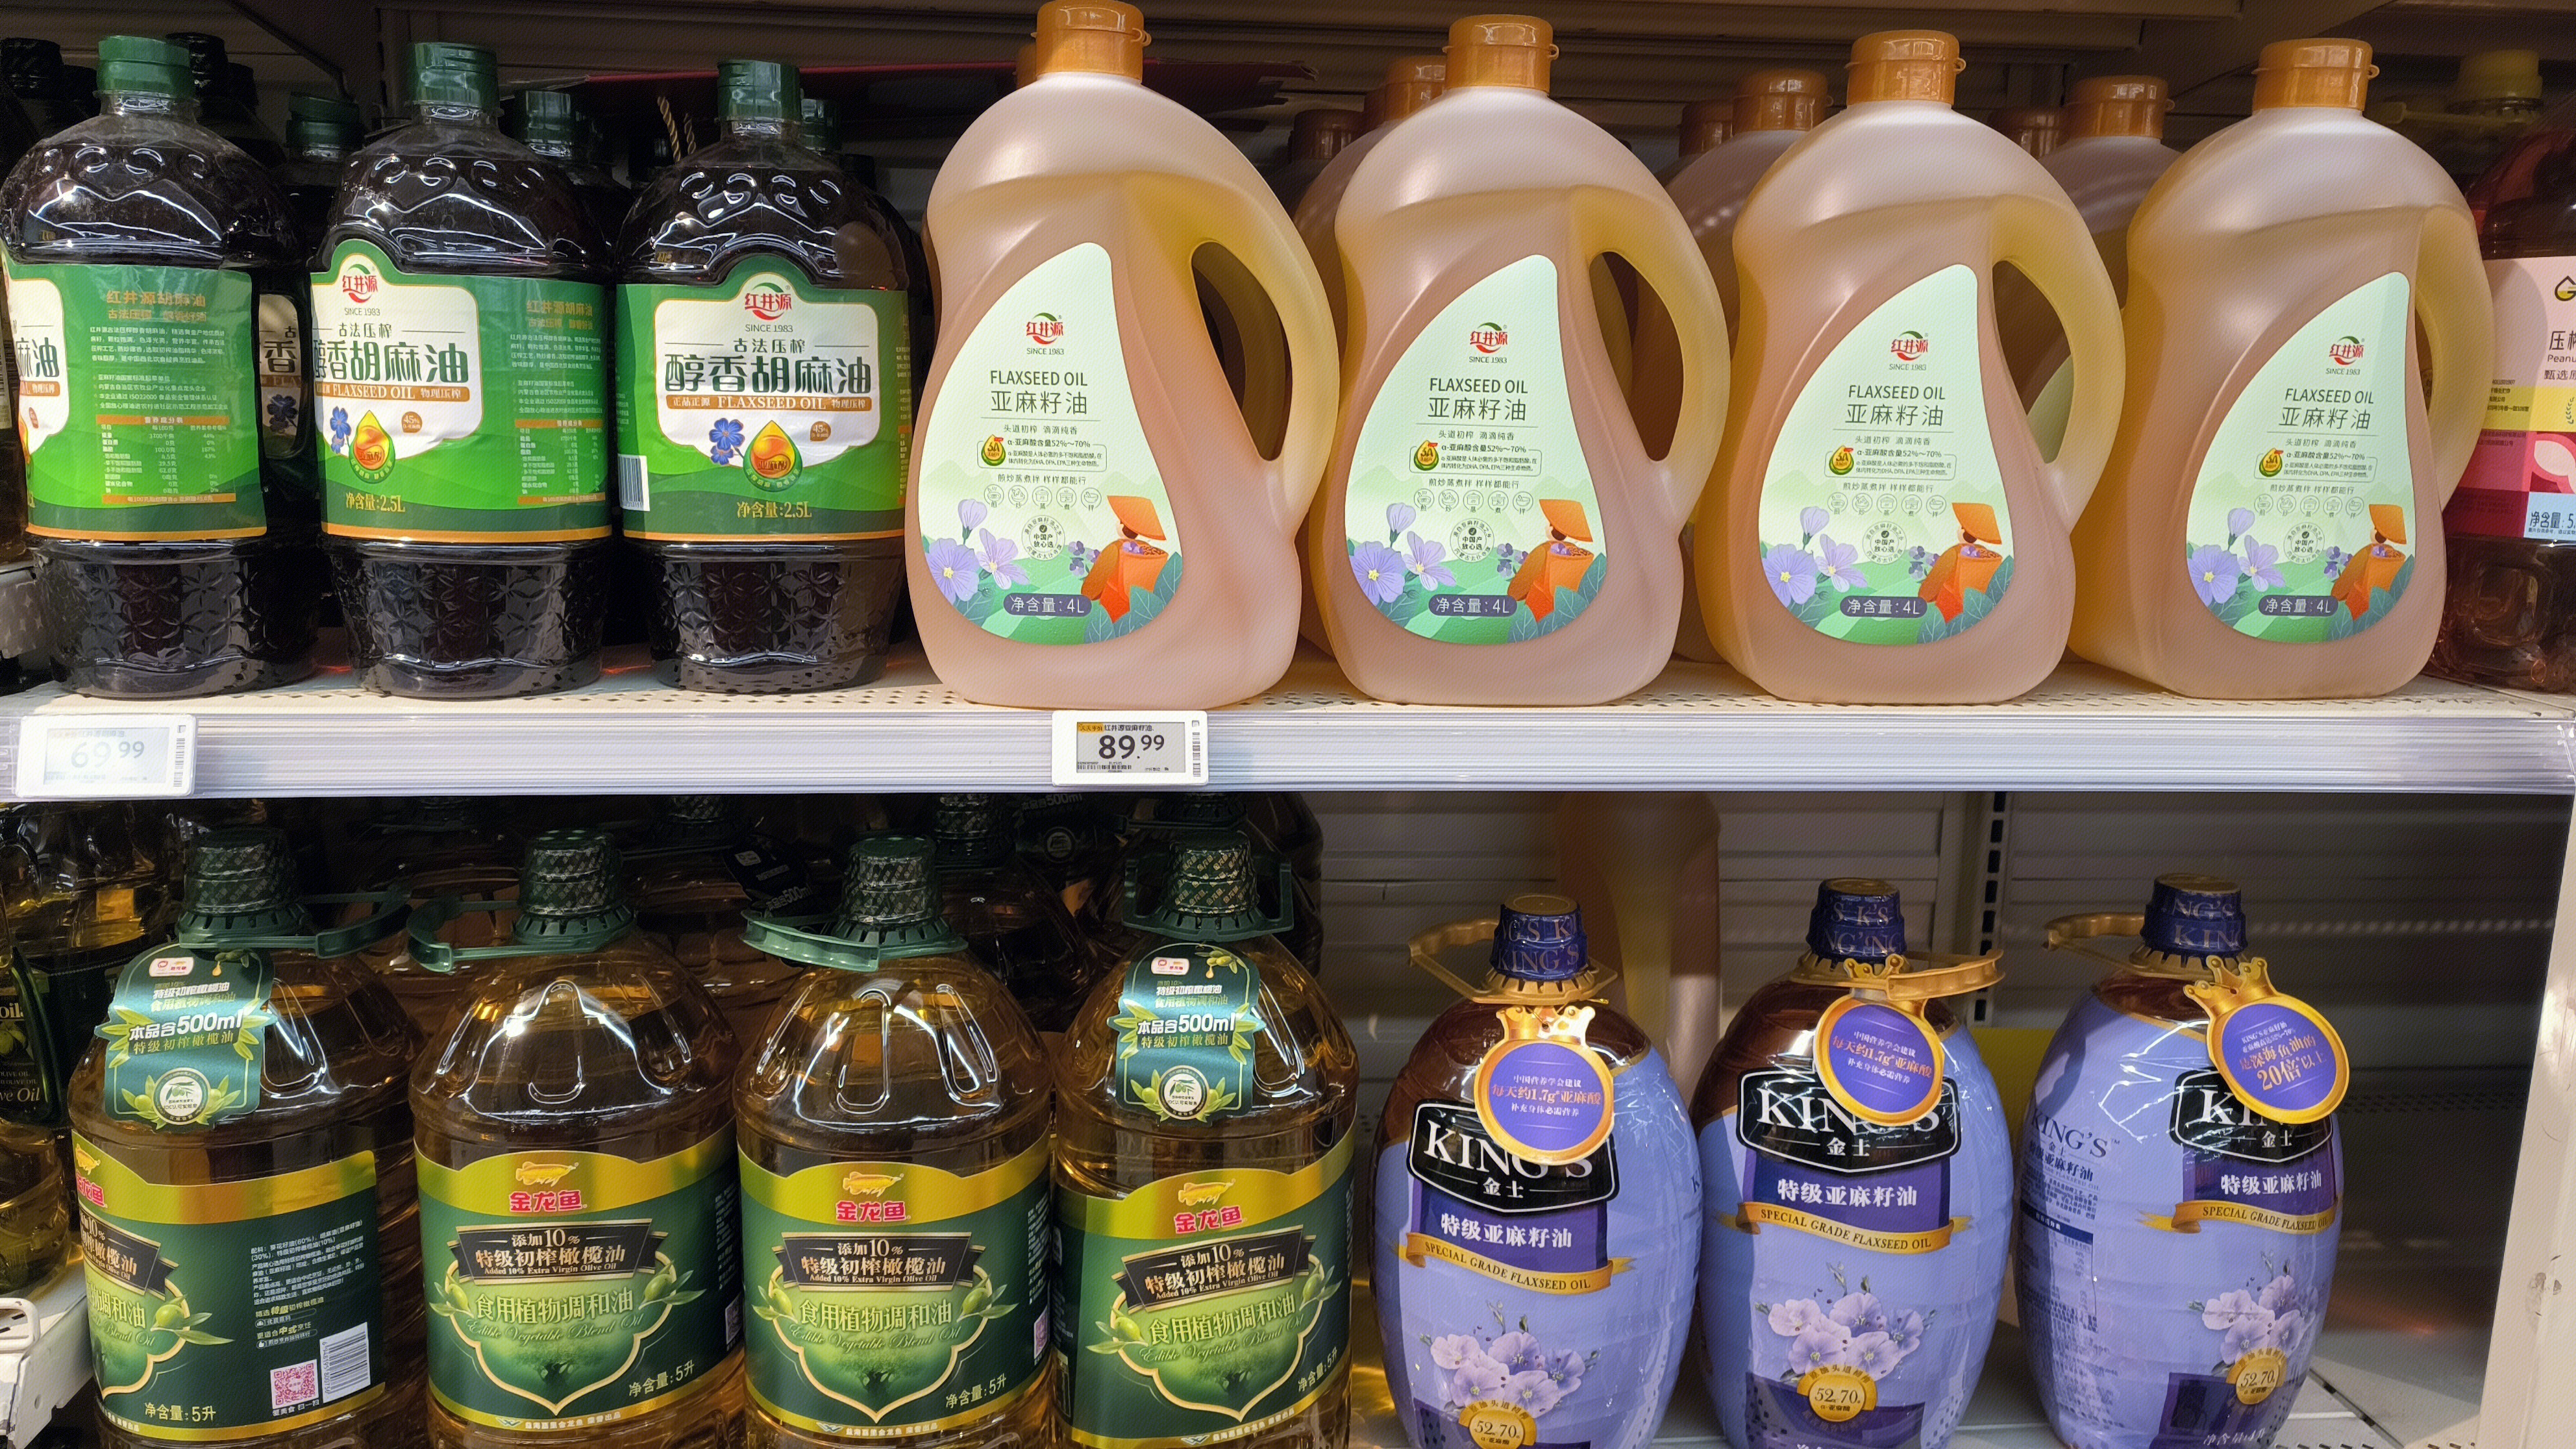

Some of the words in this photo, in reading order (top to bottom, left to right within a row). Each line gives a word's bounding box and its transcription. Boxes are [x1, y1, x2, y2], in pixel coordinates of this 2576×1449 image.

[342, 275, 378, 293] 红井源
[107, 291, 205, 307] 红井源胡麻油
[745, 293, 792, 312] 红井源
[344, 307, 362, 316] SINCE
[364, 308, 380, 316] 1983
[338, 322, 391, 339] 古法压榨
[745, 323, 771, 332] SINCE
[1026, 321, 1063, 337] 红井源
[1470, 331, 1508, 345] 红井源
[733, 338, 806, 353] 古法压榨
[1891, 339, 1928, 354] 红井源
[2329, 344, 2364, 358] 红井源
[665, 354, 871, 394] 醇香胡麻油
[991, 371, 1059, 386] FLAXSEED
[1065, 372, 1087, 386] OIL
[333, 384, 387, 398] FLAXSEED
[390, 386, 415, 399] OIL
[1430, 378, 1500, 393] FLAXSEED
[1505, 380, 1528, 393] OIL
[1849, 385, 1919, 399] FLAXSEED
[1923, 386, 1946, 400] OIL
[2285, 388, 2351, 403] FLAXSEED
[2355, 390, 2373, 404] OIL
[717, 397, 796, 408] FLAXSEED
[800, 398, 826, 409] OIL
[991, 391, 1087, 414] 亚麻籽油
[1428, 397, 1526, 421] 亚麻籽油
[1845, 404, 1944, 427] 亚麻籽油
[2279, 407, 2371, 430] 亚麻籽油
[1098, 735, 1164, 759] 89.99
[129, 1009, 243, 1040] 本品含500ml
[1137, 1013, 1236, 1034] 本品含500ml
[133, 1031, 234, 1055] 特级初榨橄榄油
[1141, 1034, 1228, 1048] 特级初榨橄榄油
[18, 1087, 40, 1102] Oil
[1827, 1137, 1871, 1156] 金士
[2262, 1130, 2292, 1148] 金士
[1483, 1177, 1524, 1198] 金士
[1777, 1179, 1917, 1208] 特级亚麻籽油
[2221, 1170, 2322, 1195] 特级亚麻籽油
[510, 1190, 582, 1213] 金龙鱼
[836, 1200, 907, 1222] 金龙鱼
[1174, 1205, 1243, 1233] 金龙鱼
[1761, 1208, 1807, 1227] SPECIAL
[1811, 1220, 1850, 1239] GRADE
[1853, 1233, 1908, 1250] FLAXSEED
[1911, 1239, 1931, 1250] OIL
[2202, 1206, 2248, 1219] SPECIAL
[2250, 1211, 2281, 1226] GRADE
[2283, 1218, 2317, 1230] FLAXSEED
[1441, 1213, 1572, 1248] 特级亚麻籽油
[476, 1245, 625, 1269] 特级初榨橄榄油
[801, 1256, 946, 1277] 特级初榨橄榄油
[1425, 1241, 1467, 1264] SPECIAL
[1470, 1257, 1507, 1279] GRADE
[1510, 1272, 1567, 1290] FLAXSEED
[1570, 1280, 1591, 1290] OIL
[528, 1265, 550, 1274] Extra
[552, 1265, 578, 1274] Virgin
[580, 1263, 602, 1272] Olive
[810, 1274, 832, 1282] Added
[852, 1275, 874, 1283] Extra
[876, 1275, 900, 1284] Virgin
[1145, 1252, 1285, 1294] 特级初榨橄榄油
[1156, 1289, 1179, 1300] Added
[1199, 1283, 1220, 1293] Extra
[1222, 1278, 1246, 1289] Virgin
[1247, 1273, 1267, 1284] Olive
[1268, 1270, 1279, 1279] Oil
[475, 1287, 634, 1324] 食用植物调和油
[800, 1299, 952, 1333] 食用植物调和油
[465, 1318, 501, 1339] Edible
[504, 1327, 563, 1347] Vegetable
[567, 1322, 615, 1341] Blend
[621, 1313, 643, 1330] Oil
[1148, 1292, 1296, 1346] 食用植物调和油
[789, 1323, 825, 1344] Edible
[828, 1333, 885, 1354] Vegetable
[889, 1331, 935, 1348] Blend
[939, 1325, 961, 1342] Oil
[1139, 1347, 1181, 1363] Edible
[1183, 1341, 1239, 1363] Vegetable
[1243, 1329, 1282, 1348] Blend
[1285, 1313, 1304, 1330] Oil
[628, 1359, 695, 1398] 净含量:5升
[1297, 1346, 1339, 1393] 净含量:5升
[945, 1374, 1007, 1409] 净含量:5升
[145, 1402, 216, 1422] 净含量:5升
